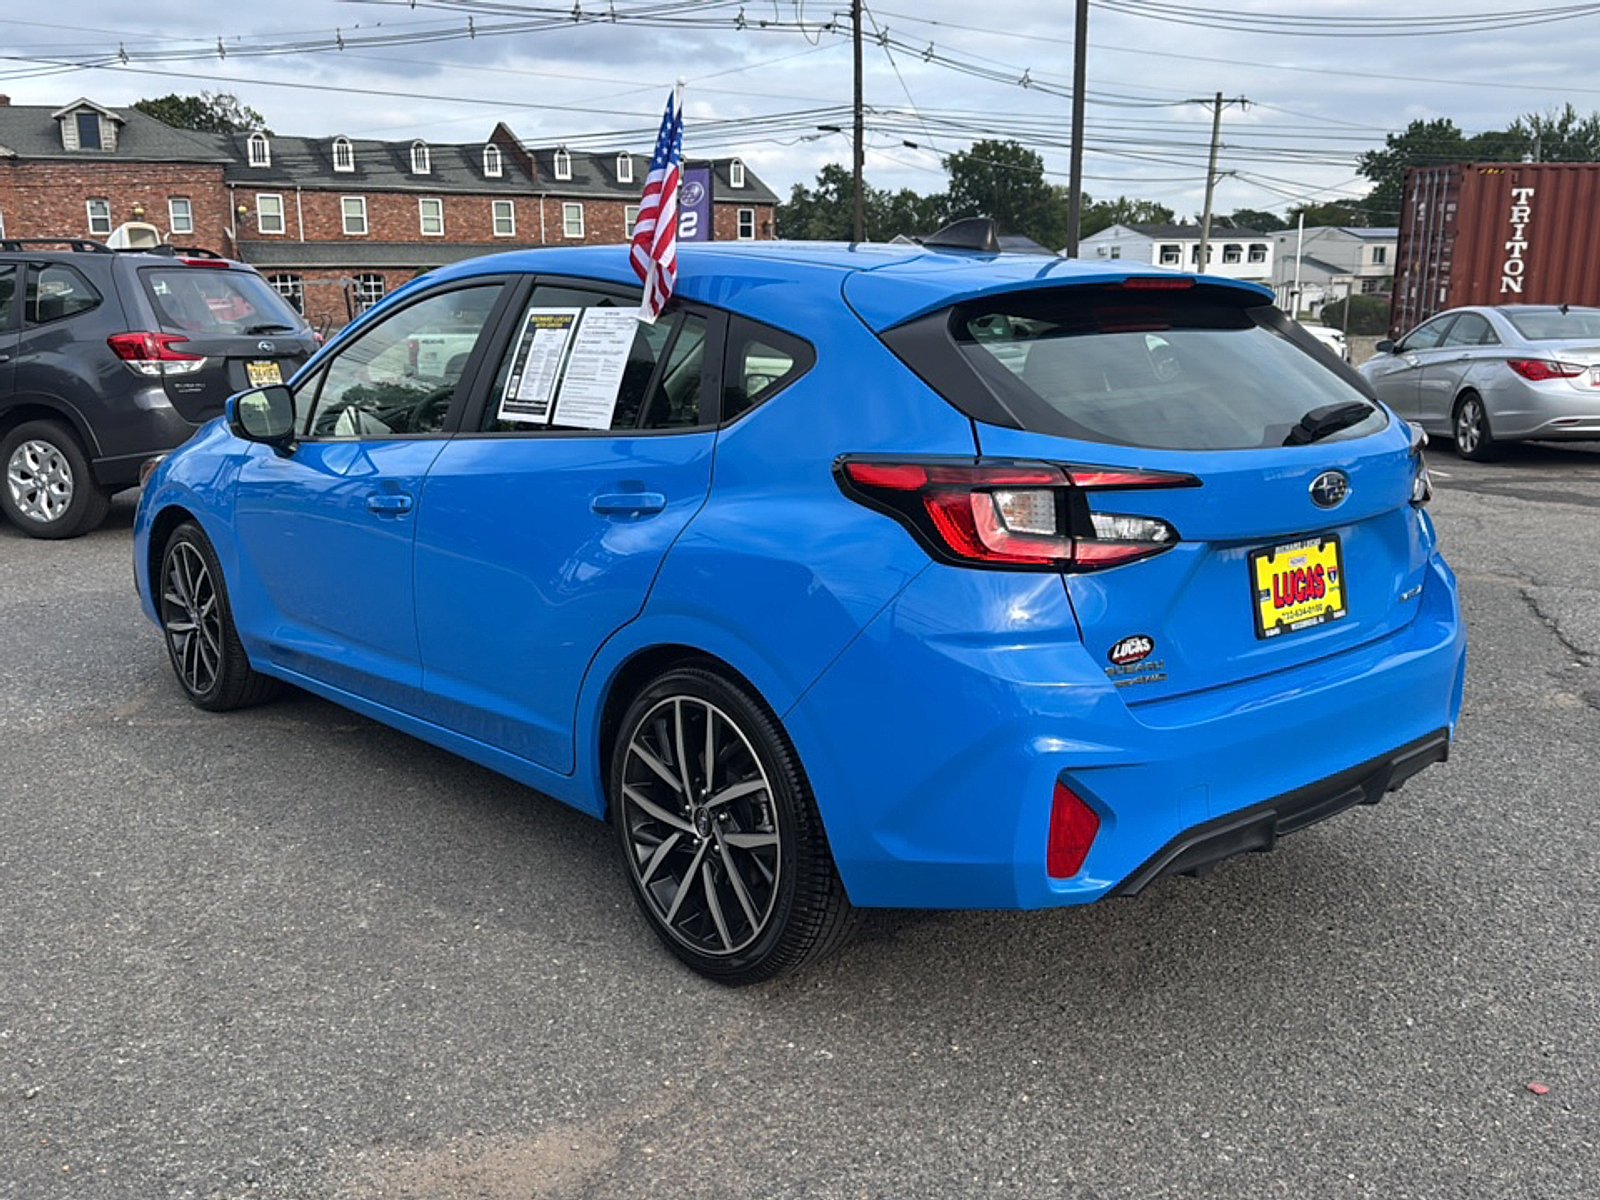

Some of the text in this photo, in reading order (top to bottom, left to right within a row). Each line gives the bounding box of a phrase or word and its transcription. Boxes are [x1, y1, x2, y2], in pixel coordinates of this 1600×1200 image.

[1500, 188, 1534, 293] TRITON
[1273, 564, 1325, 609] LUCAS
[1113, 637, 1151, 658] LUCAS
